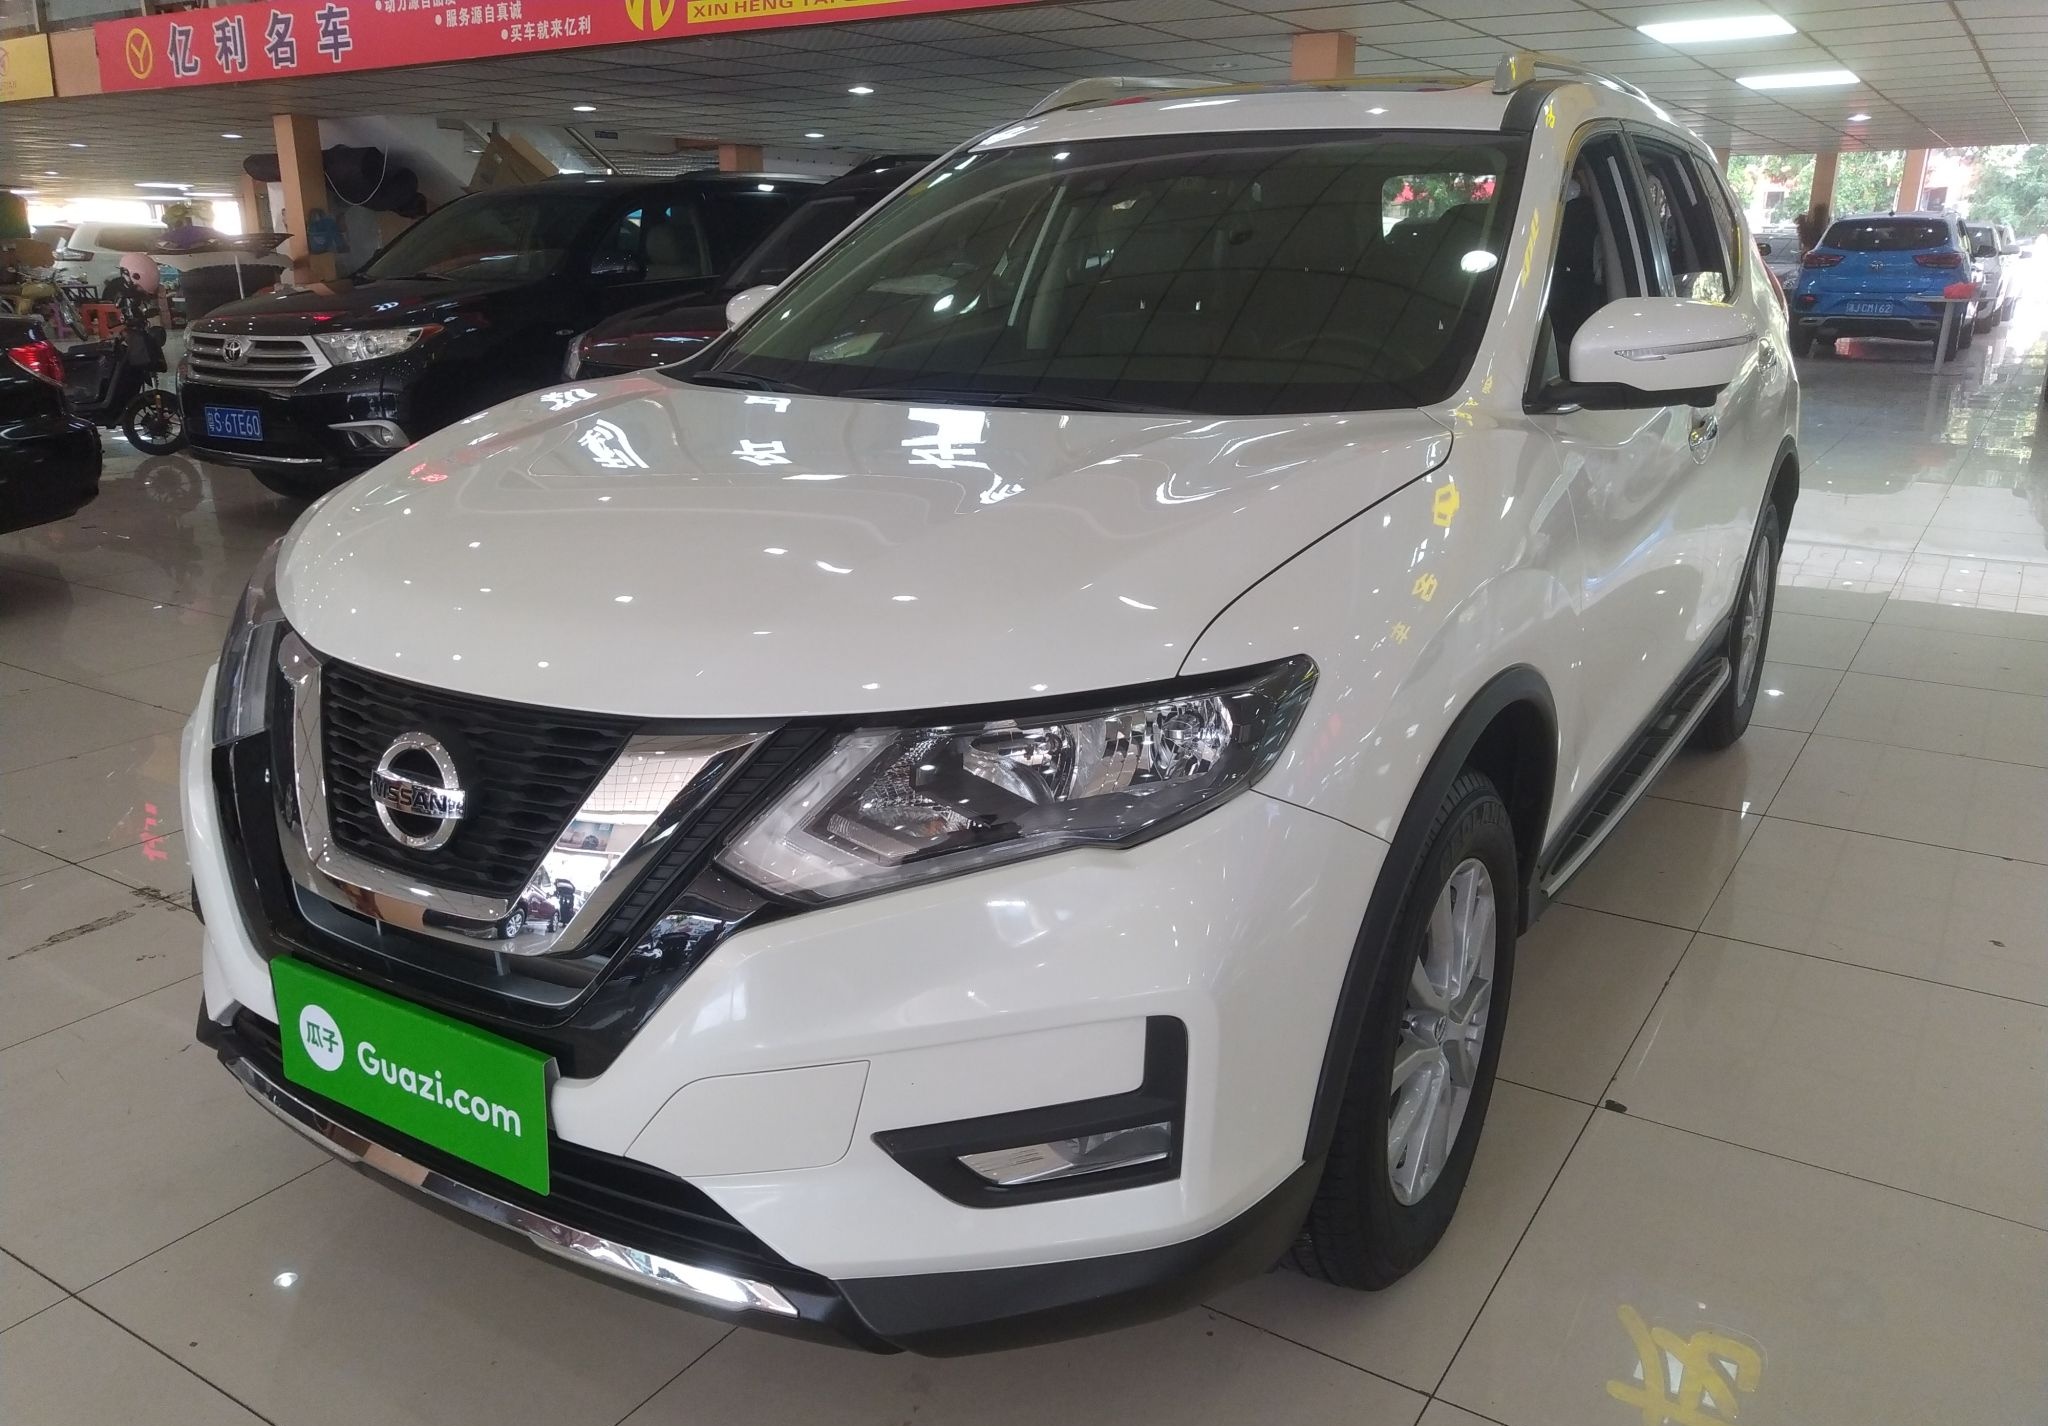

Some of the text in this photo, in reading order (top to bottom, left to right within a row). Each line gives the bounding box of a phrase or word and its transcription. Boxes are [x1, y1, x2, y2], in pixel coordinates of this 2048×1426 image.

[446, 1, 522, 27] 服务源自真诚
[693, 3, 728, 18] XIN
[734, 0, 793, 14] HENG
[167, 3, 352, 78] 亿利名车
[510, 15, 591, 42] 买车就来亿利
[372, 777, 448, 813] NISSAN
[306, 1020, 339, 1053] 瓜子
[357, 1041, 522, 1138] Guazi.com
